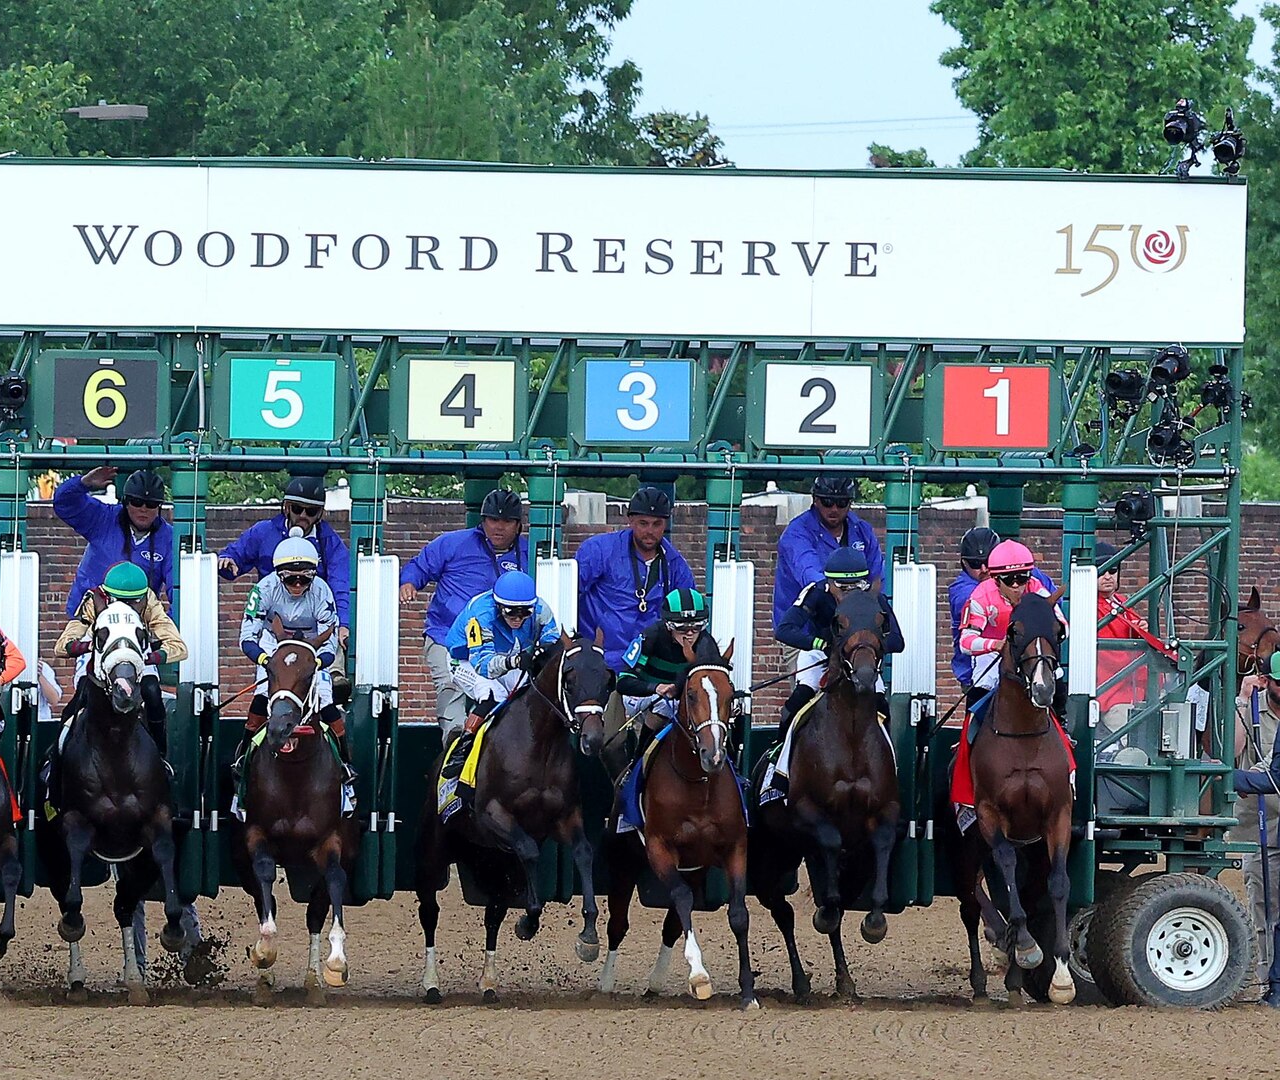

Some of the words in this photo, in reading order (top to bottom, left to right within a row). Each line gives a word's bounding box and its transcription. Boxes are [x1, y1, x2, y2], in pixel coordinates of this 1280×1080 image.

[73, 224, 499, 272] WOODFORD
[82, 369, 128, 430] 6
[260, 370, 305, 429] 5
[440, 373, 483, 428] 4
[616, 371, 660, 431] 3
[798, 377, 837, 433] 2
[983, 378, 1011, 436] 1
[247, 590, 258, 611] 5
[469, 625, 477, 642] 4
[627, 642, 640, 661] 3
